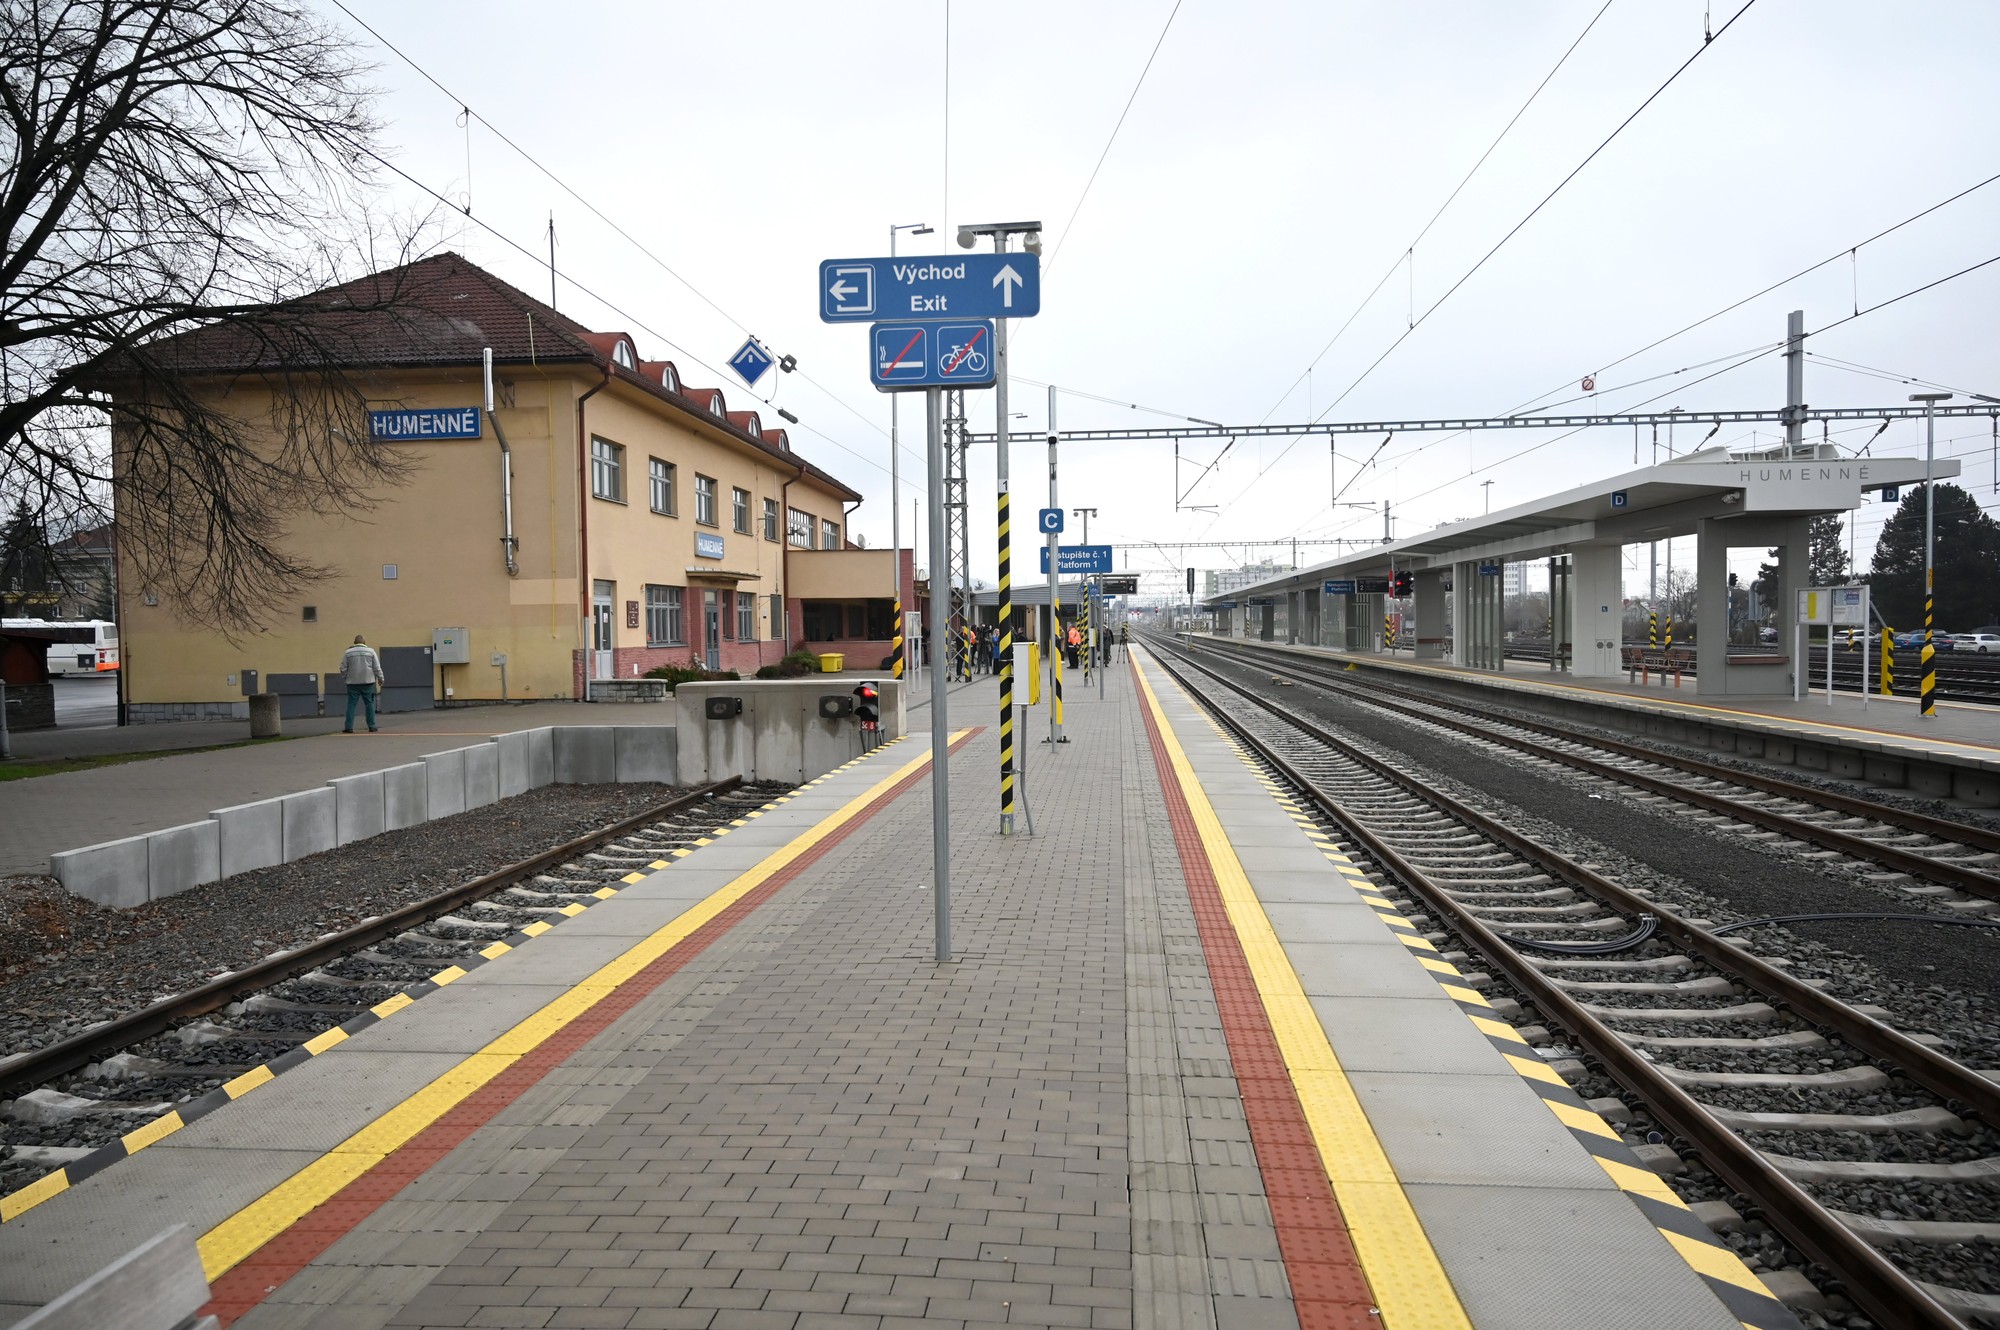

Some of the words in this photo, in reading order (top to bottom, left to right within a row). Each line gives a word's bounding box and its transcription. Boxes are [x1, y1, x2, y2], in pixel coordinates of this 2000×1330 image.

[892, 263, 965, 285] Východ
[910, 295, 947, 312] Exit
[373, 409, 475, 435] HUMENNÉ
[1740, 466, 1870, 482] HUMENNÉ
[1003, 480, 1008, 491] 1
[1616, 494, 1625, 505] D
[1886, 489, 1896, 500] D
[1045, 513, 1058, 529] C
[1045, 550, 1090, 560] Nstupište
[1092, 550, 1100, 558] č.
[1103, 550, 1107, 558] 1
[870, 721, 874, 730] 8
